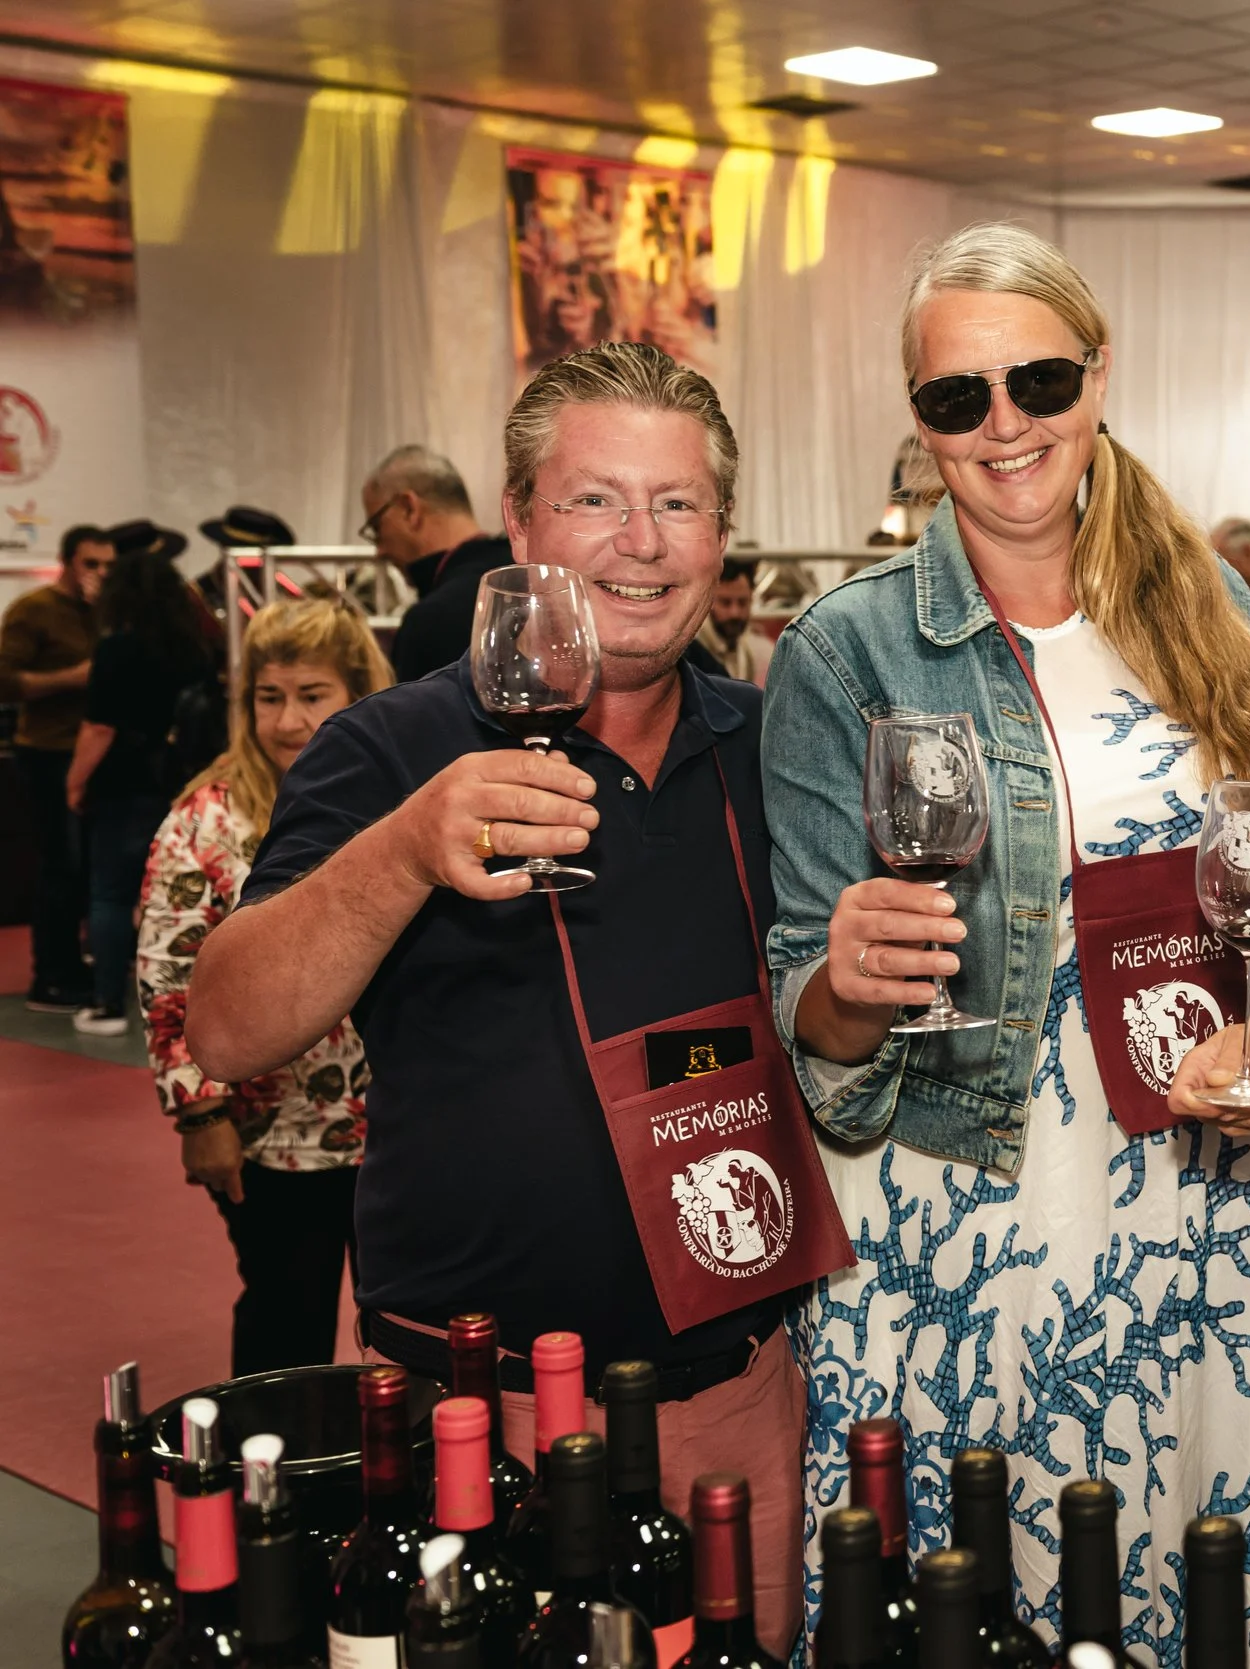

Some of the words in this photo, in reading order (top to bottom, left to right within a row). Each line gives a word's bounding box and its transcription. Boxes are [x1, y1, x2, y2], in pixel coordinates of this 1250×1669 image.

[1112, 931, 1224, 970] MEMÓRIAS
[1113, 933, 1162, 948] RESTAURANTE
[1169, 951, 1226, 969] MEMORIES
[649, 1101, 707, 1123] RESTAURANTE
[652, 1091, 769, 1147] MEMÓRIAS
[718, 1113, 772, 1137] MEMORIES
[715, 1265, 732, 1278] DO
[732, 1253, 778, 1279] BACCHUS
[776, 1241, 788, 1258] DE
[783, 1177, 795, 1243] ALBUFEIRA
